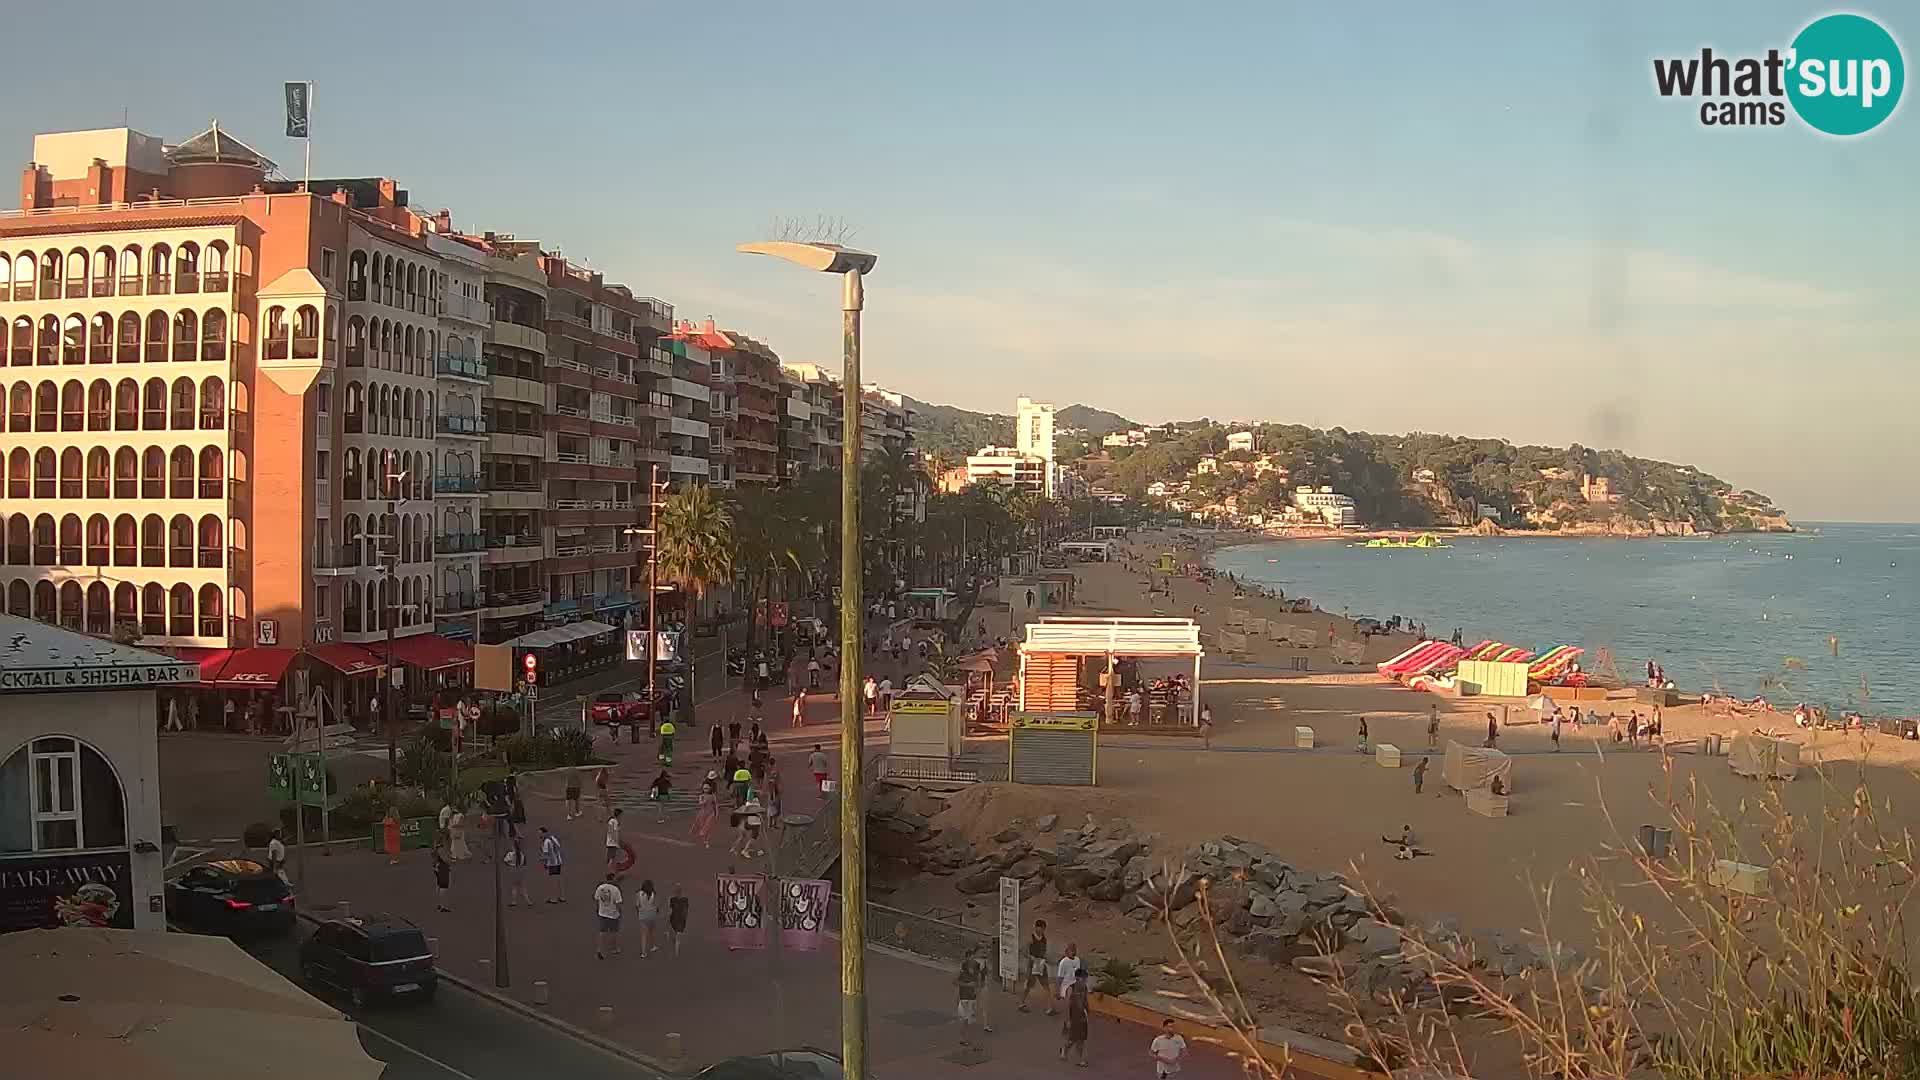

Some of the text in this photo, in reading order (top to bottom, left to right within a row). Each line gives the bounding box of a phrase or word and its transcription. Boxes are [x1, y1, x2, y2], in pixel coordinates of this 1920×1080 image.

[315, 627, 333, 643] KFC
[64, 671, 76, 685] &
[81, 669, 142, 684] SHISHA
[147, 667, 179, 681] BAR
[232, 673, 269, 681] KFC
[0, 869, 58, 889] TAKE
